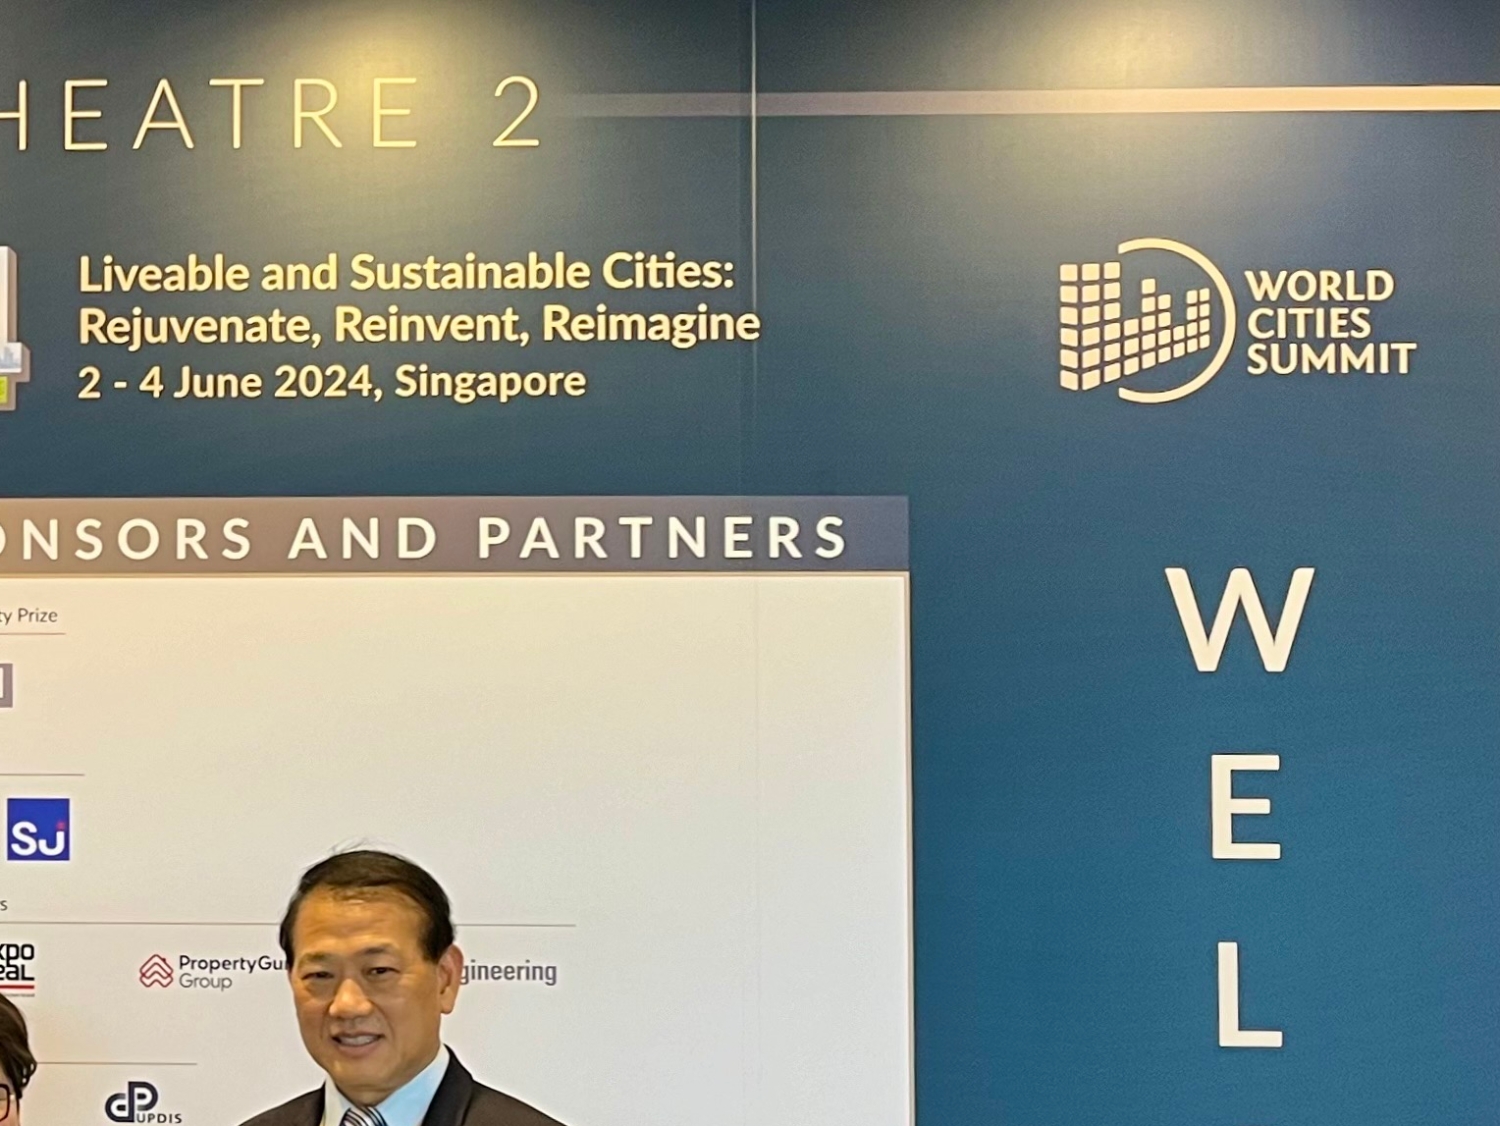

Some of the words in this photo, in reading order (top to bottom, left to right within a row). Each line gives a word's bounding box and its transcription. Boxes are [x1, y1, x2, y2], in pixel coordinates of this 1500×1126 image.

[492, 75, 540, 147] 2
[78, 254, 251, 293] Liveable
[261, 253, 339, 292] and
[350, 251, 591, 291] Sustainable
[602, 250, 735, 290] Cities:
[1244, 269, 1395, 302] WORLD
[78, 307, 323, 352] Rejuvenate,
[334, 305, 531, 348] Reinvent,
[542, 303, 761, 349] Reimagine
[1246, 306, 1372, 340] CITIES
[1246, 342, 1417, 376] SUMMIT
[77, 366, 102, 399] 2
[139, 365, 164, 399] 4
[173, 366, 263, 399] June
[275, 364, 383, 403] 2024,
[395, 363, 587, 404] Singapore
[287, 516, 438, 560] AND
[478, 515, 846, 560] PARTNERS
[17, 607, 58, 623] Prize
[179, 955, 288, 974] PropertyGu
[460, 958, 558, 986] gineering
[179, 972, 233, 992] Group
[136, 1113, 182, 1124] UPDIS
